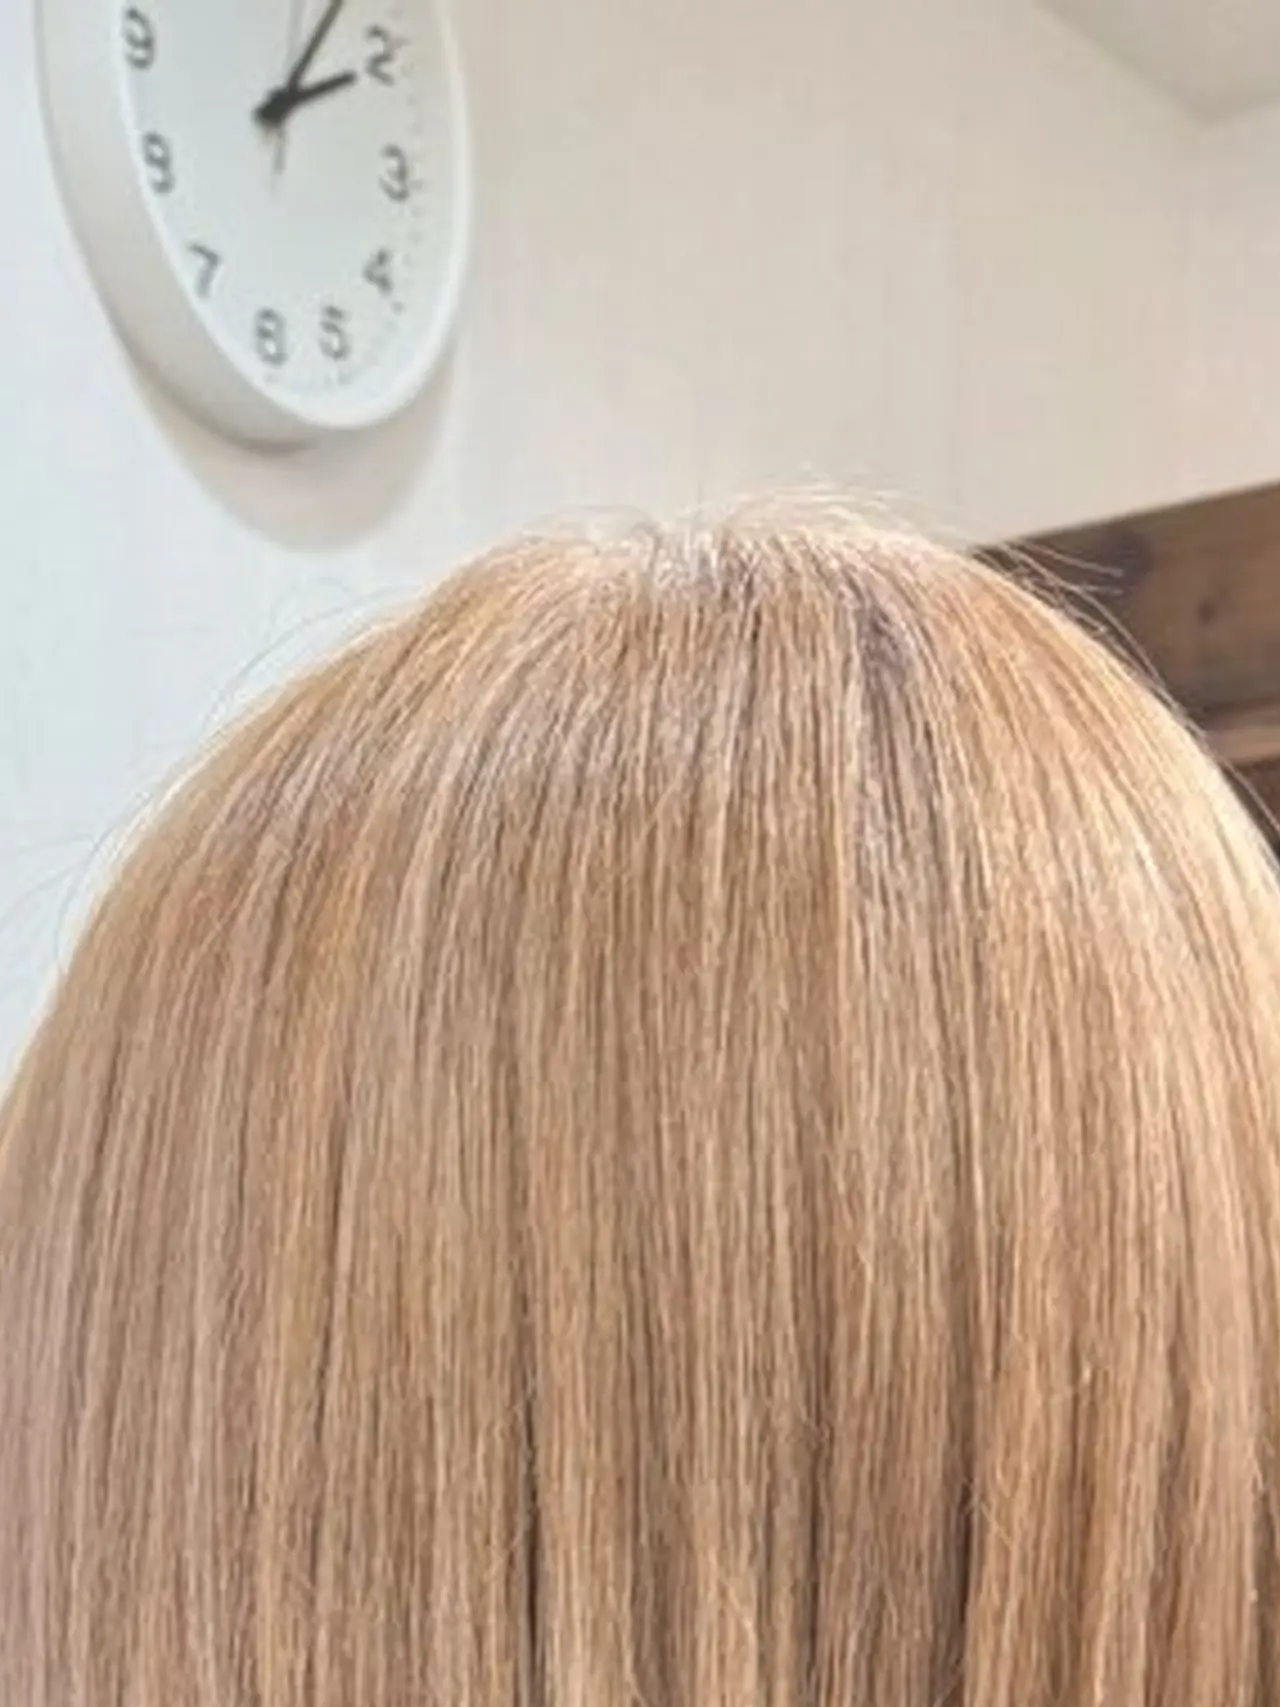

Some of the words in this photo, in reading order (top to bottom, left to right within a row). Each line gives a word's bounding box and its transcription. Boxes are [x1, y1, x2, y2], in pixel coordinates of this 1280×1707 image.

[124, 7, 155, 70] 9
[365, 24, 395, 86] 2
[378, 144, 410, 202] 3
[188, 243, 221, 298] 7
[364, 249, 392, 293] 4
[320, 305, 350, 360] 5
